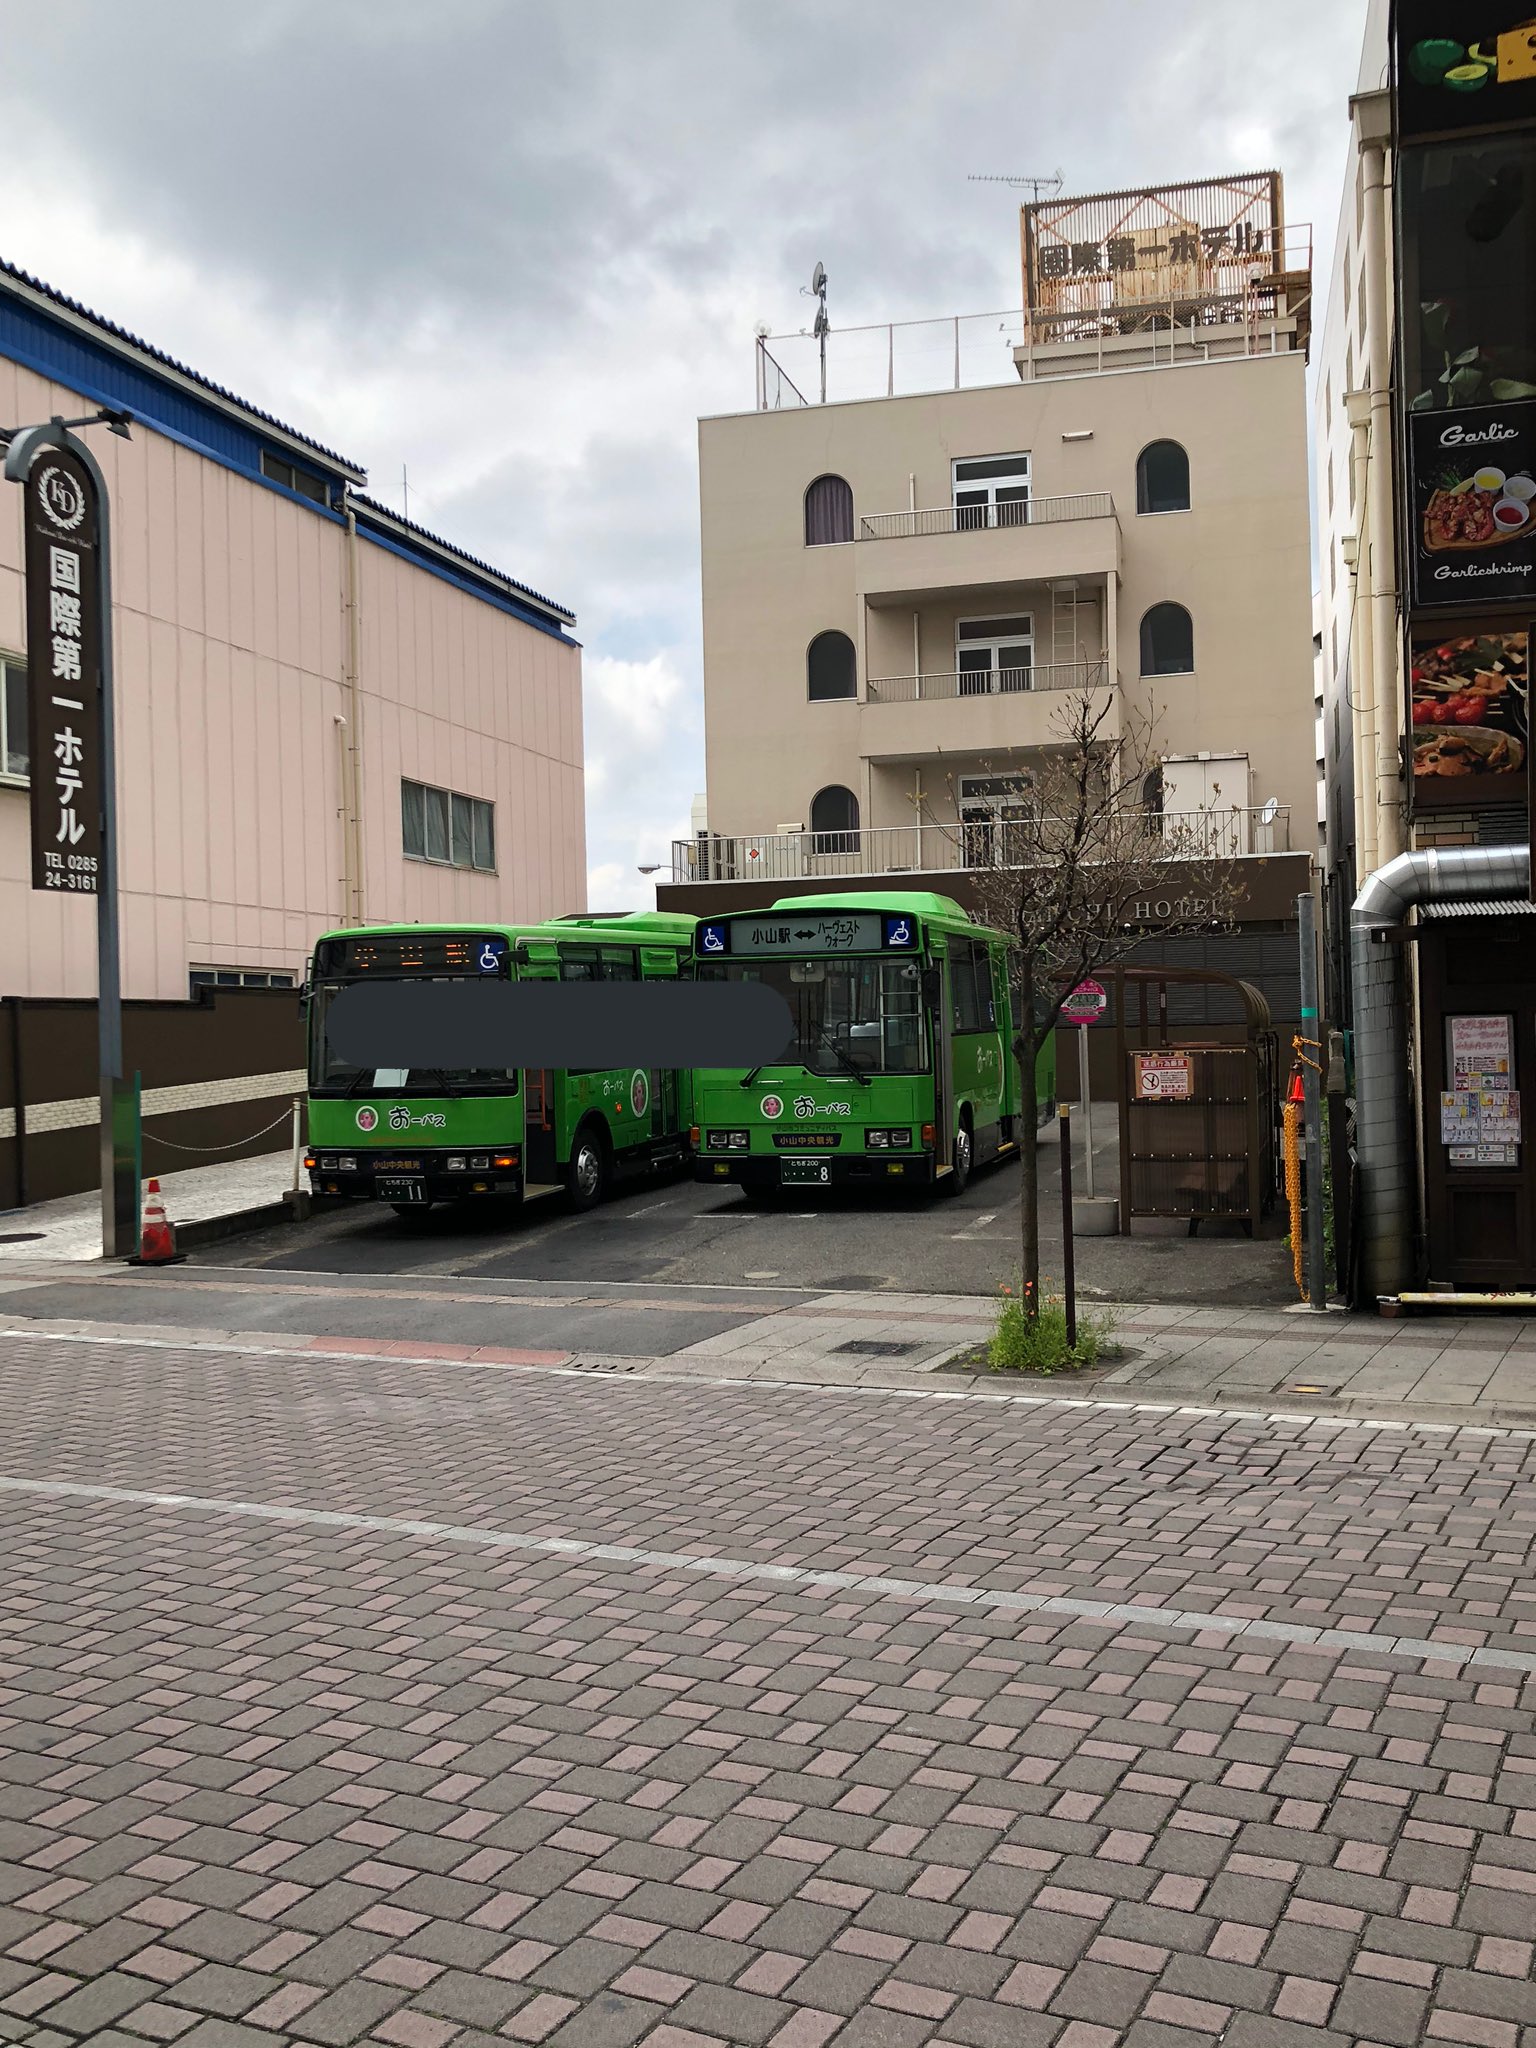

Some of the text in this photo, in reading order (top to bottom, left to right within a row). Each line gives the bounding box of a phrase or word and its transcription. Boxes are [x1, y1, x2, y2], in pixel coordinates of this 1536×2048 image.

[1040, 221, 1263, 279] 国際第一ホテル
[1439, 423, 1519, 446] Garlic
[1434, 562, 1533, 580] Garlicshrimp
[49, 546, 86, 846] 国際第一ホテル
[43, 852, 98, 872] TEL 0285
[45, 871, 97, 891] 24-3161
[1134, 898, 1224, 920] HOTEL
[751, 919, 861, 945] 小山駅 ハーヴェスト
[824, 934, 854, 948] ウォーク
[388, 1106, 446, 1130] おーバス
[793, 1095, 851, 1119] おーバス
